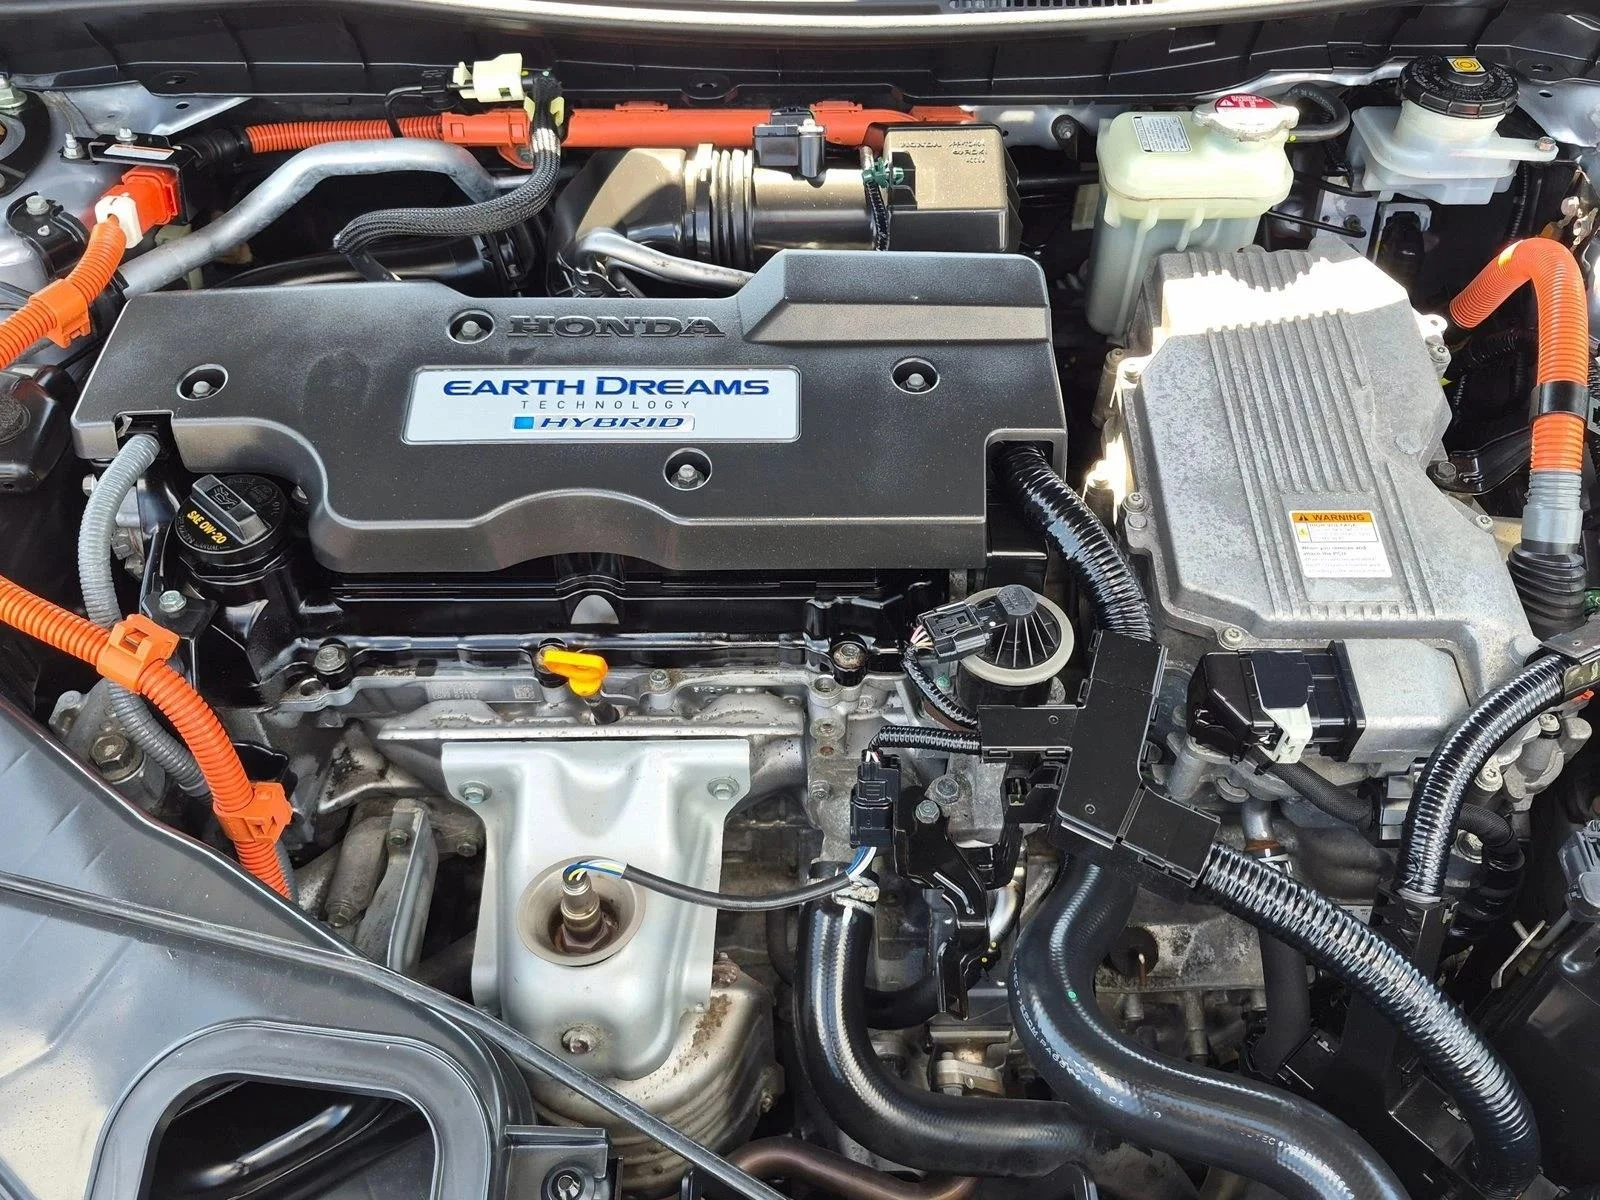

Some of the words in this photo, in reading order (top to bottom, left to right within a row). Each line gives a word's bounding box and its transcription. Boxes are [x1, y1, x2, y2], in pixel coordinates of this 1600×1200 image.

[507, 315, 726, 338] HONDA
[443, 379, 585, 396] EARTH
[595, 376, 770, 396] DREAMS
[521, 400, 690, 410] TECHNOLOGY
[540, 417, 684, 428] HYBRID
[187, 510, 205, 525] SAE
[199, 521, 227, 544] 0W-20
